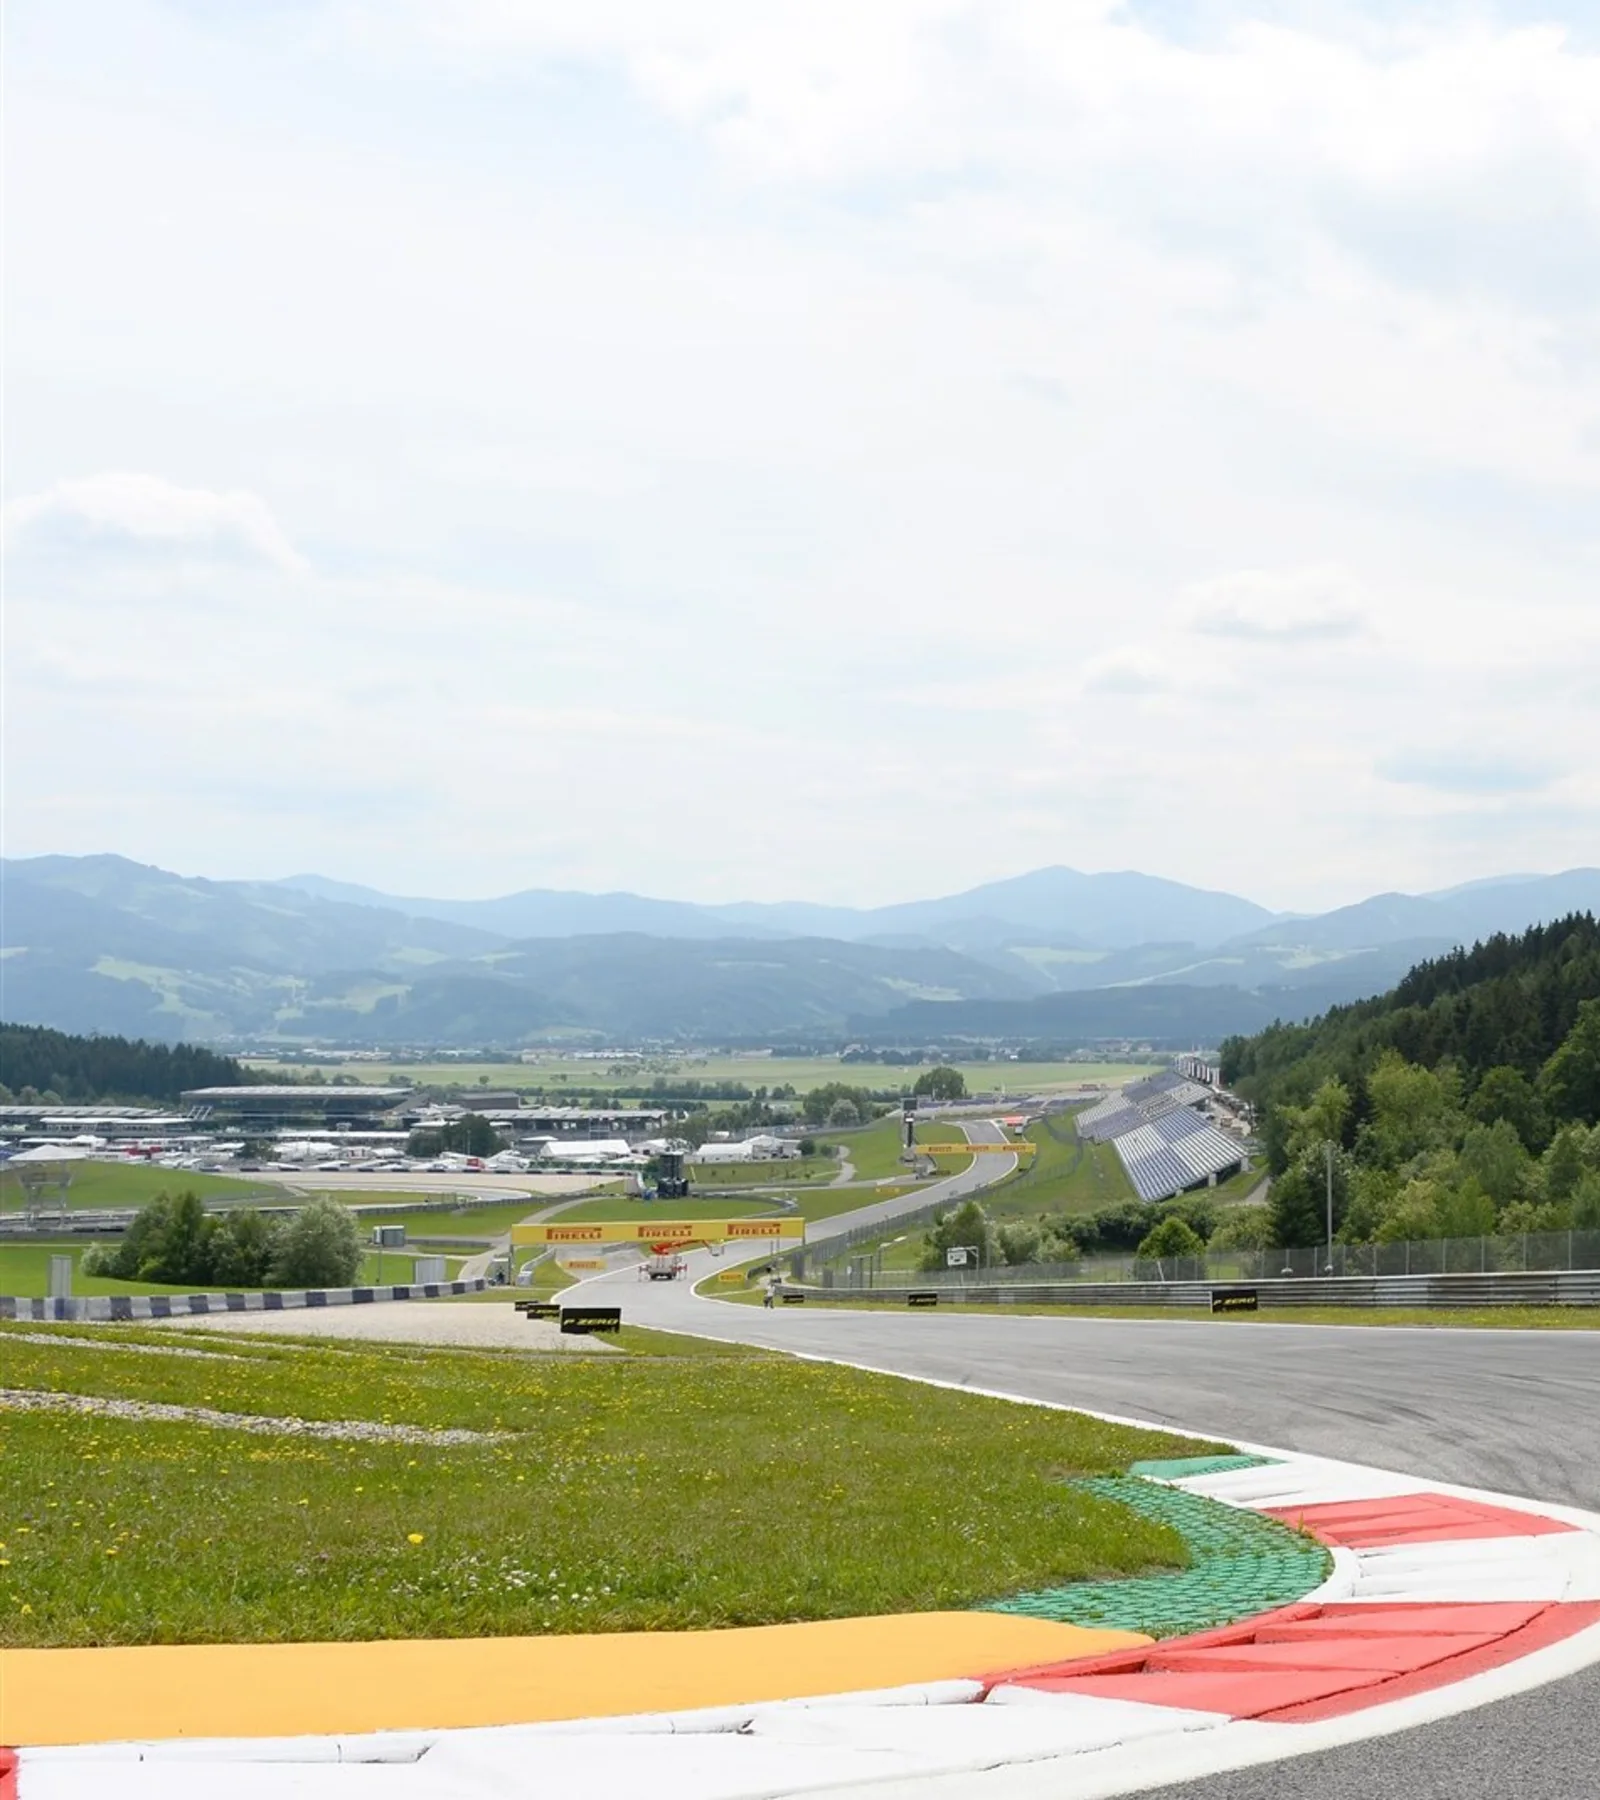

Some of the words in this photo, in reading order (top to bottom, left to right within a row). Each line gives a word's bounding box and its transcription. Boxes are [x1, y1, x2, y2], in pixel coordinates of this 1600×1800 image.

[546, 1227, 602, 1240] PIRELLI
[638, 1225, 693, 1238] PIRELLI
[727, 1223, 781, 1236] PIRELLI
